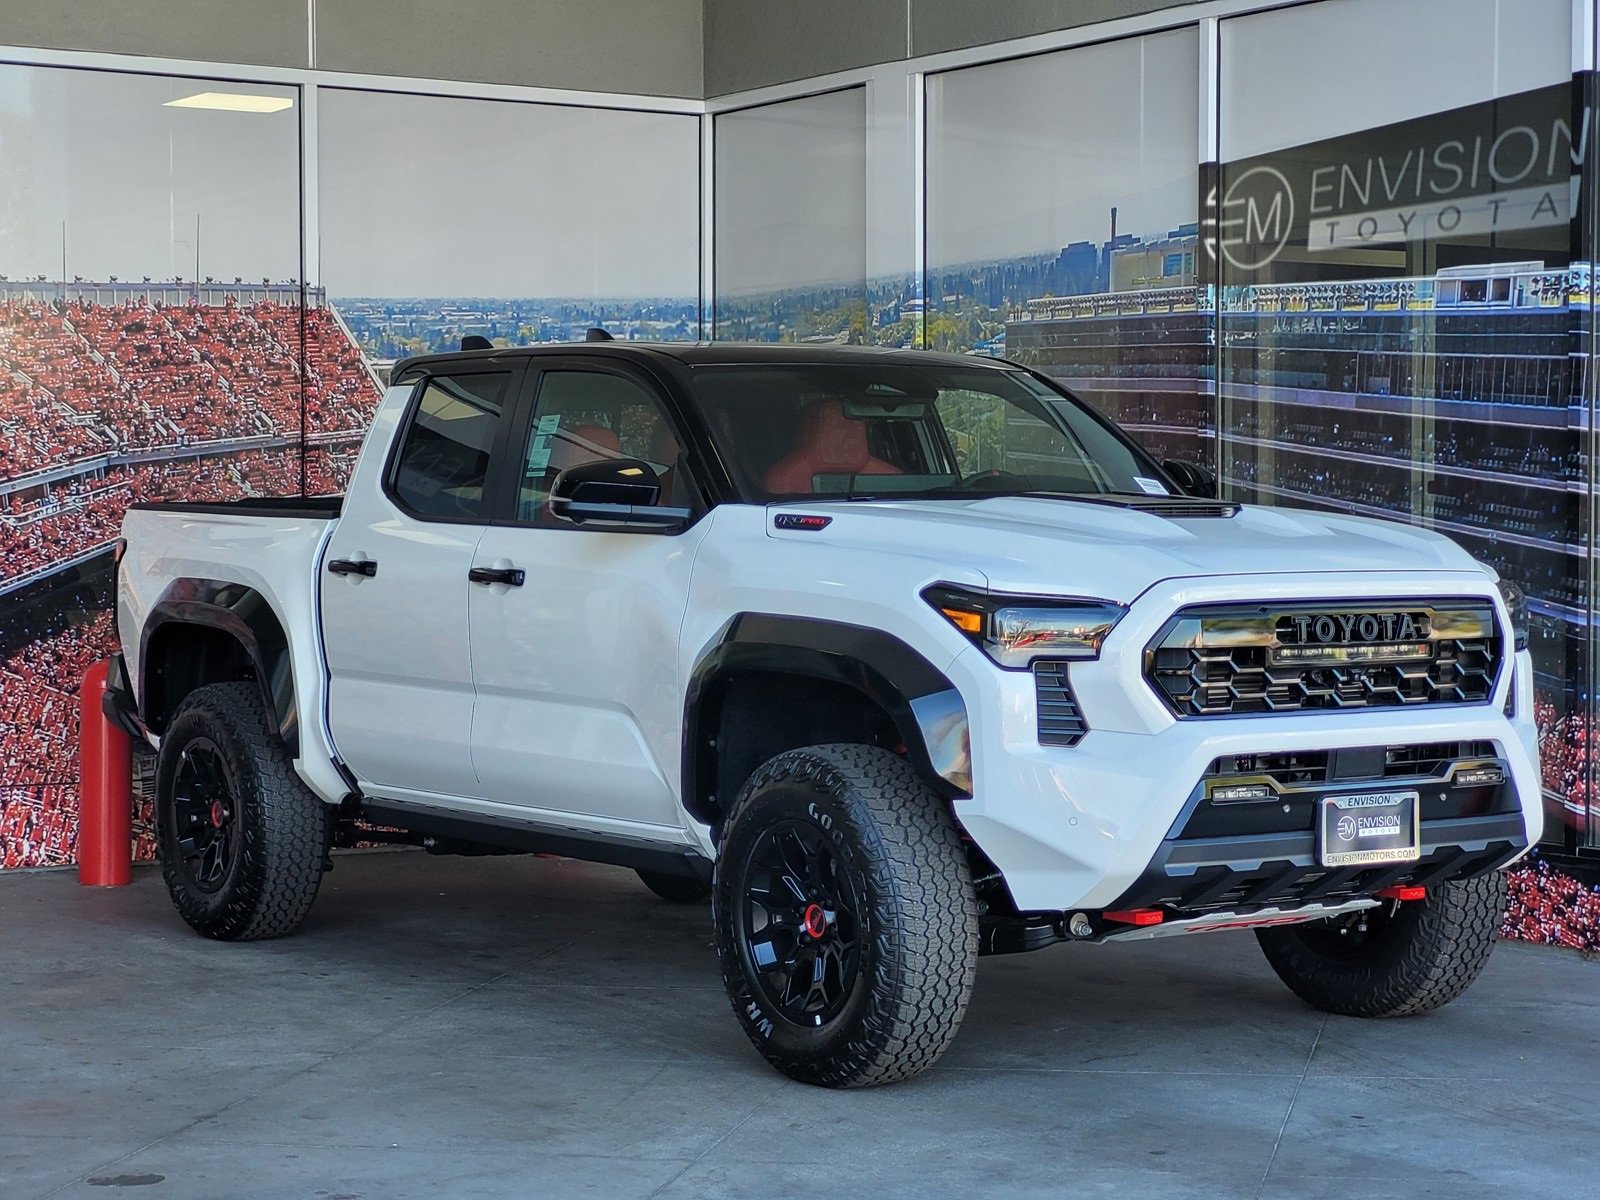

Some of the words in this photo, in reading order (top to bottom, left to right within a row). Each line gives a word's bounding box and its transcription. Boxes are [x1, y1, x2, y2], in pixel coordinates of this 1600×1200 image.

[1310, 106, 1590, 213] ENVISION
[1326, 192, 1558, 244] TOYOTA
[1292, 612, 1418, 643] TOYOTA
[1348, 795, 1391, 807] ENVISION
[1358, 815, 1401, 828] ENVISION
[1327, 850, 1416, 864] ENVISIONMOTORS.COM
